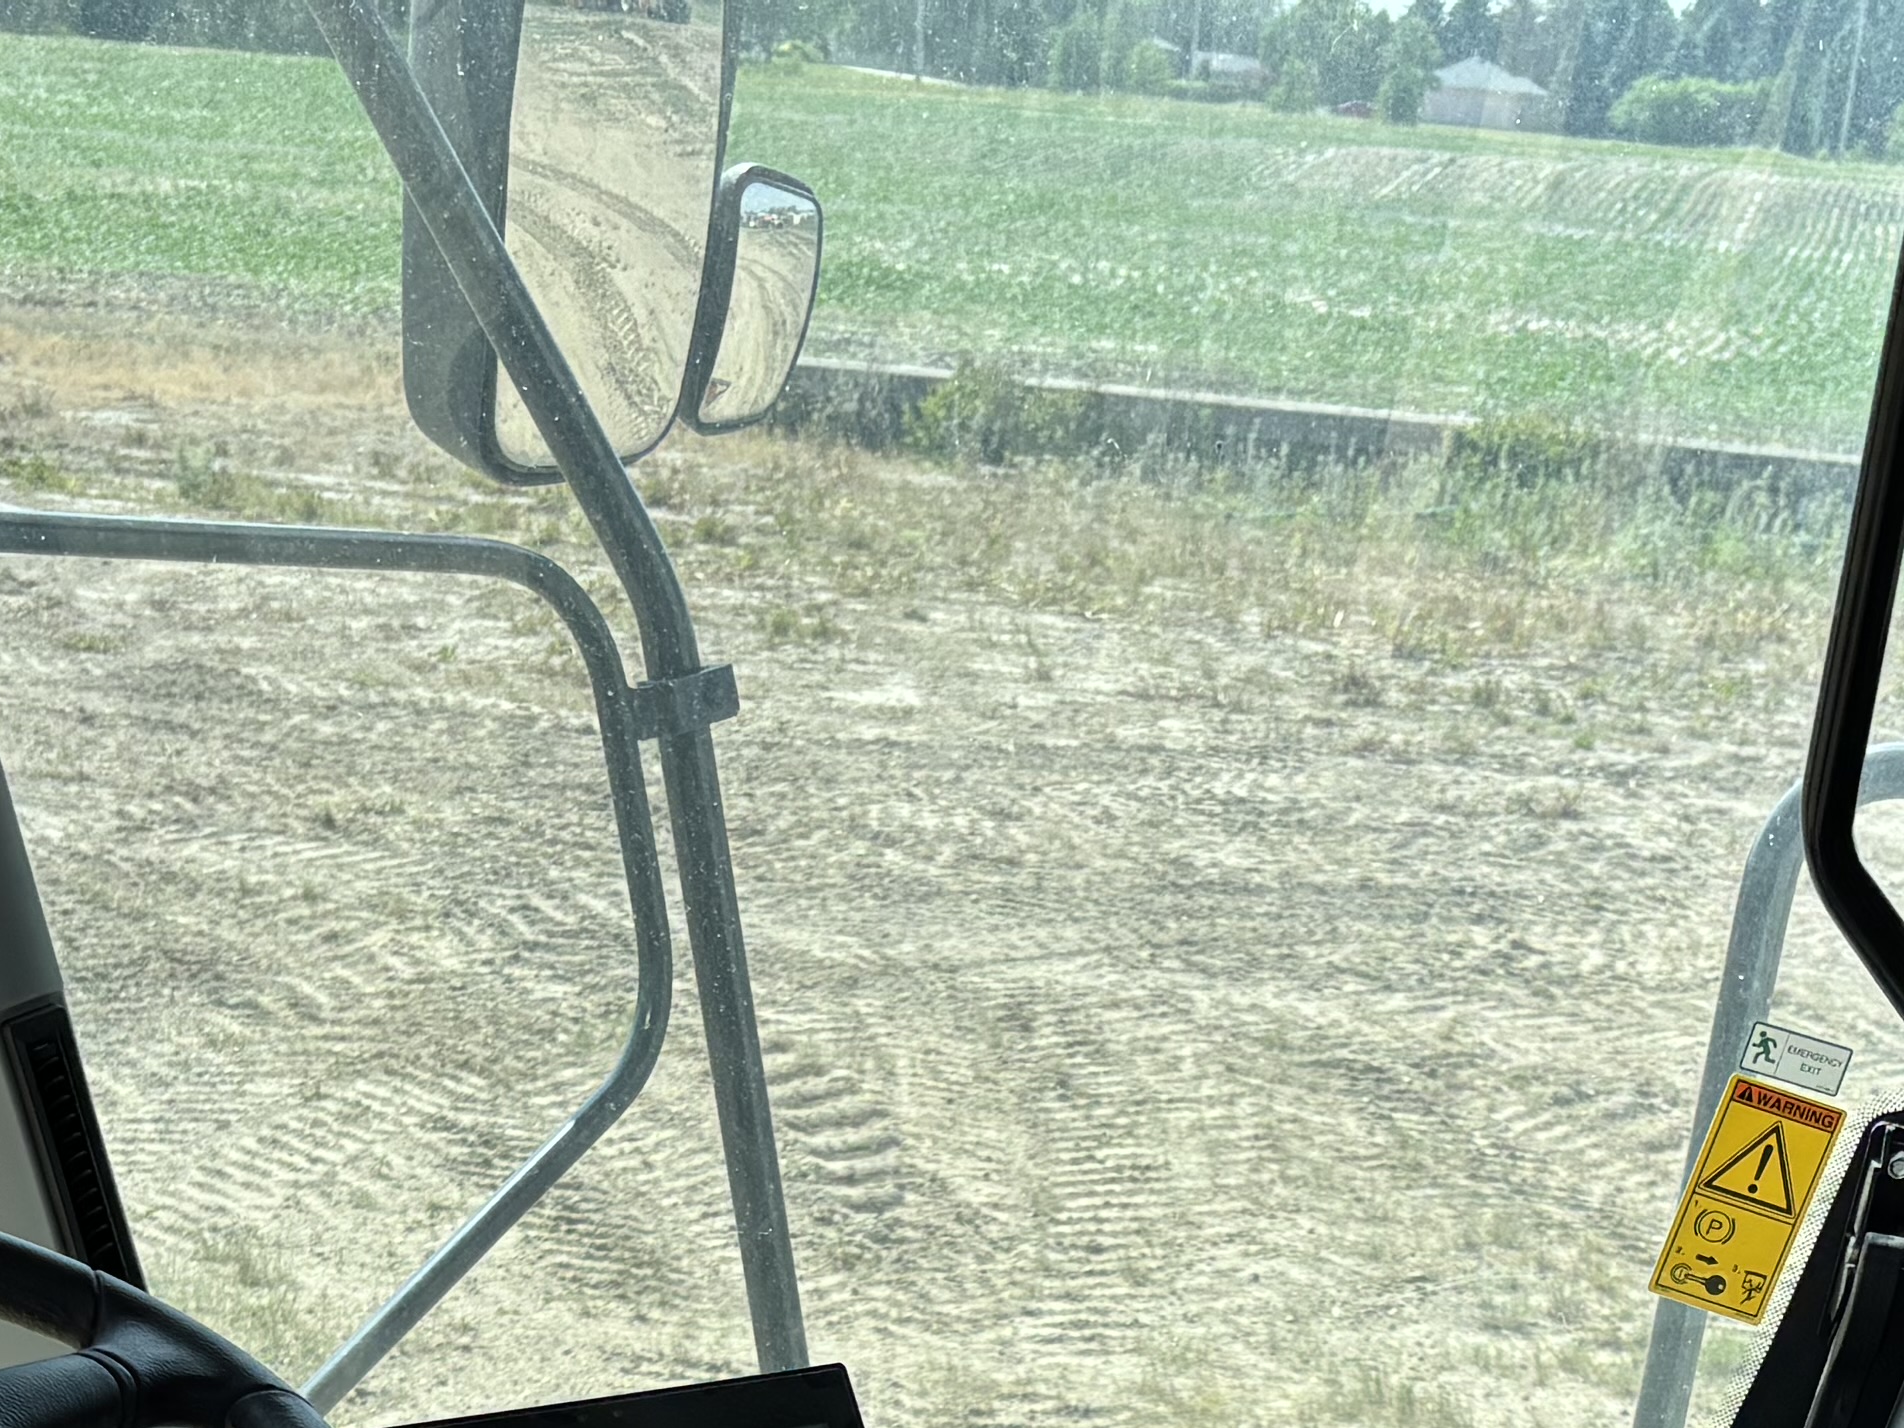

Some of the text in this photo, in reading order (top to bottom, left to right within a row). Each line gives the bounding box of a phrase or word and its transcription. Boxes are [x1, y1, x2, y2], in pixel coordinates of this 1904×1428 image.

[1787, 1045, 1842, 1068] EMERGENCY
[1800, 1063, 1822, 1076] EXIT
[1757, 1090, 1835, 1129] WARNING
